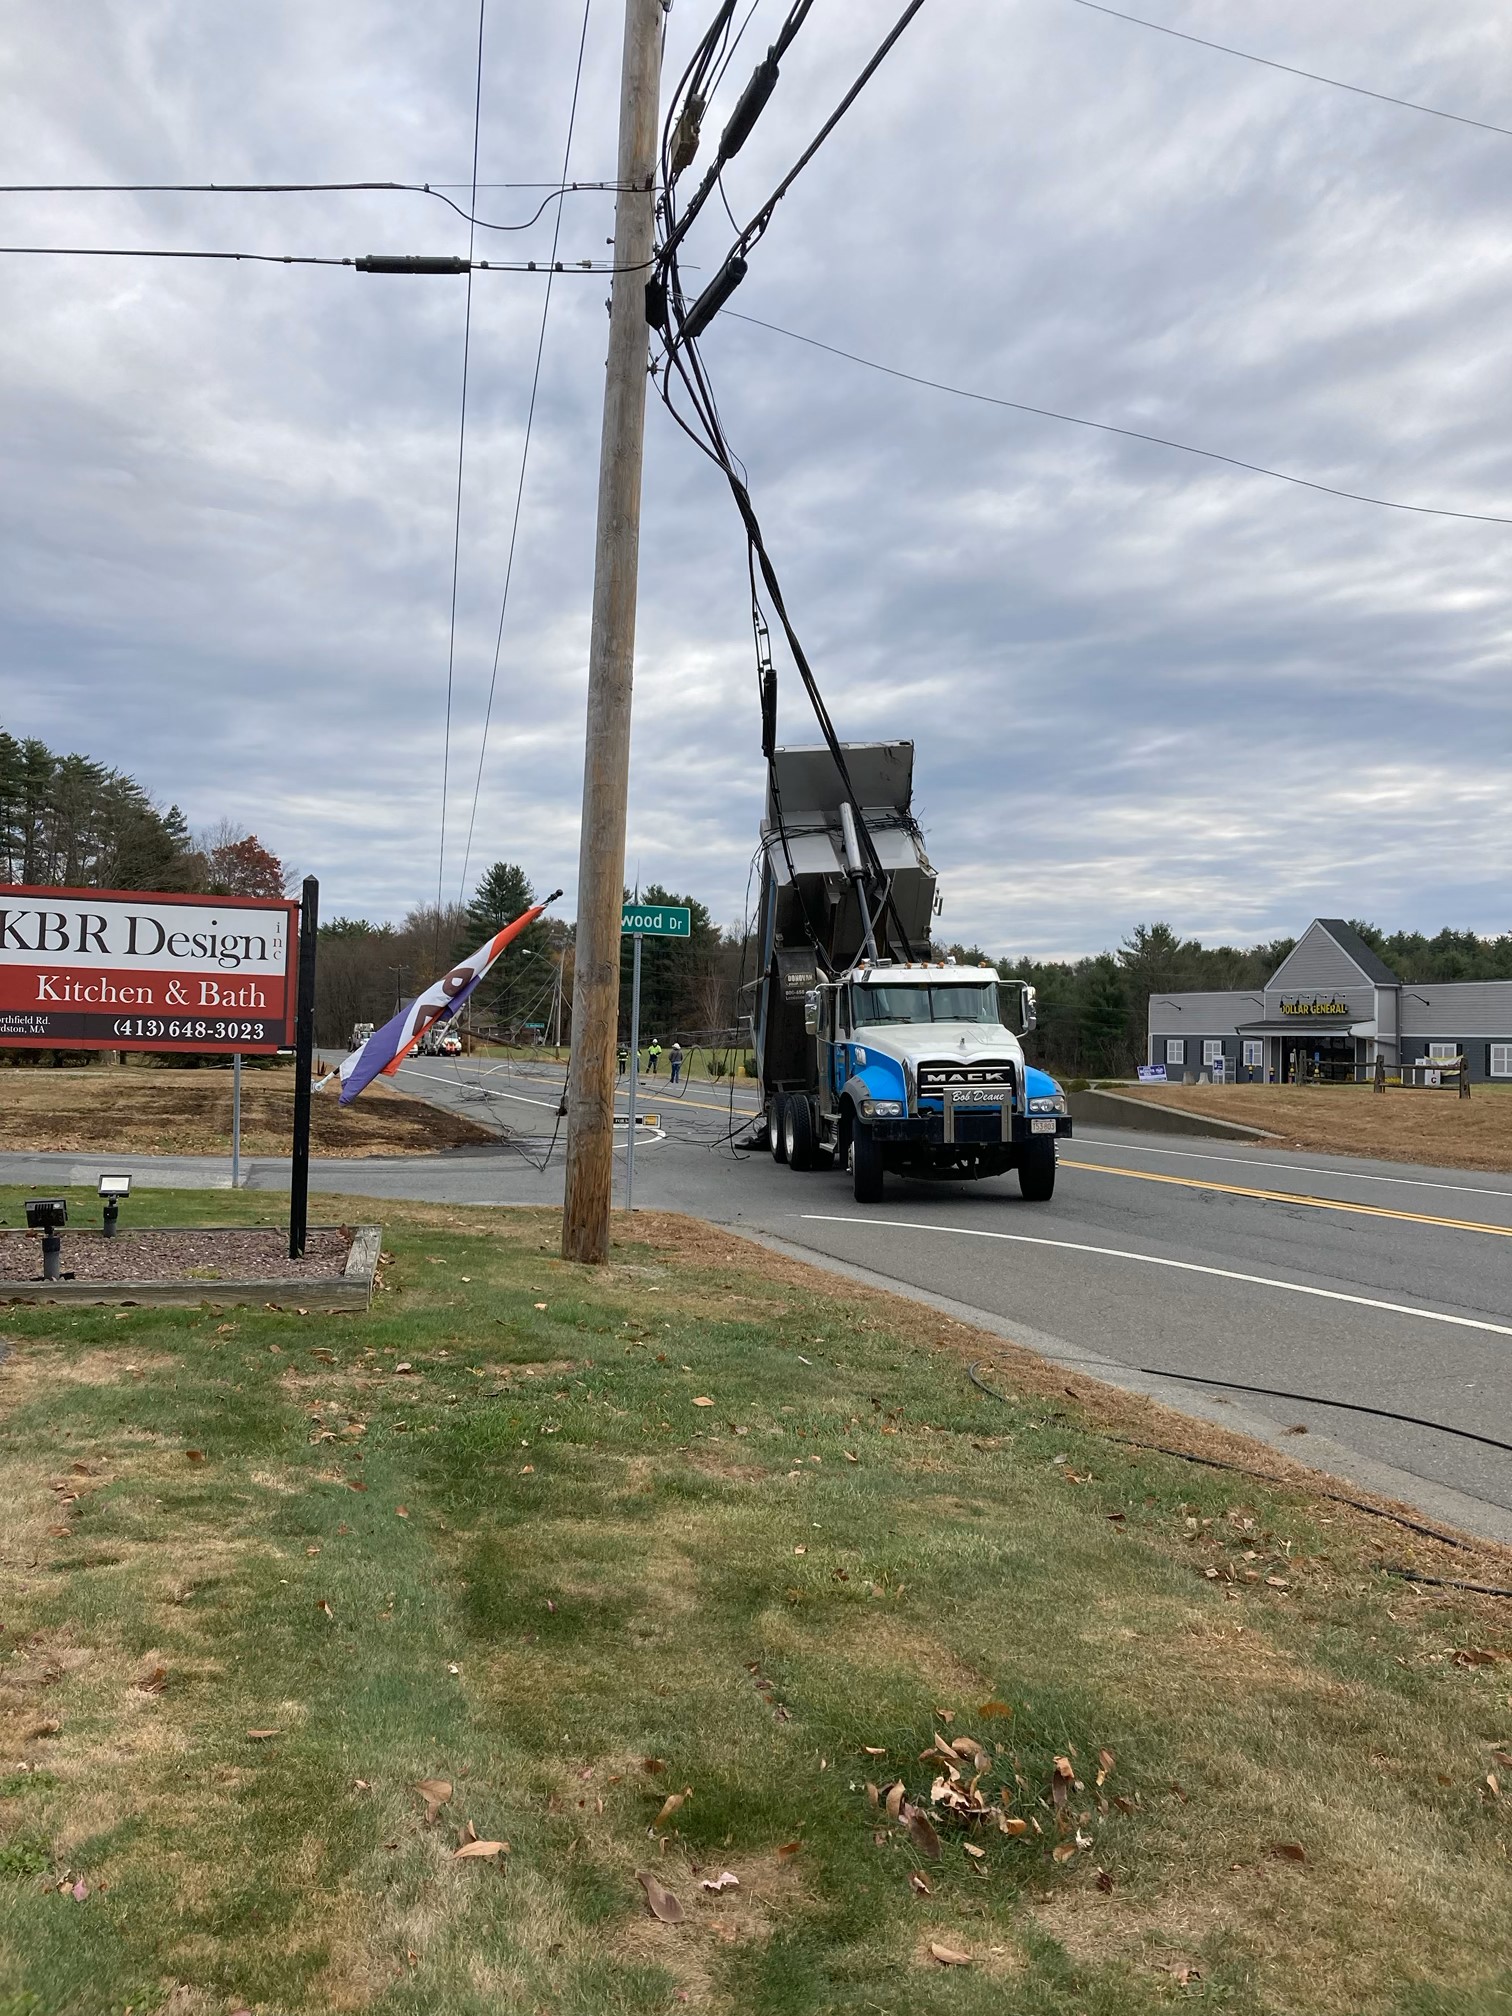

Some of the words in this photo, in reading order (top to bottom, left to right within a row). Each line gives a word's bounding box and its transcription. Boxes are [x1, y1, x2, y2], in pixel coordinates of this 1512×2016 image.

[621, 913, 662, 928] wood
[669, 917, 682, 929] Dr
[0, 910, 112, 954] KBR
[123, 916, 269, 969] Design
[273, 921, 282, 961] inc
[35, 974, 153, 1004] Kitchen
[165, 979, 190, 1006] &
[198, 981, 266, 1008] Bath
[1281, 1004, 1309, 1014] DOLLAR
[1311, 1004, 1346, 1013] GENERAL
[0, 1015, 33, 1025] rthfield
[36, 1016, 51, 1025] Rd.
[30, 1025, 45, 1034] MA
[113, 1019, 165, 1037] (413)
[168, 1021, 265, 1040] 648-3023
[927, 1072, 1005, 1082] MACK
[951, 1090, 971, 1103] Bob
[973, 1090, 1005, 1102] Deane
